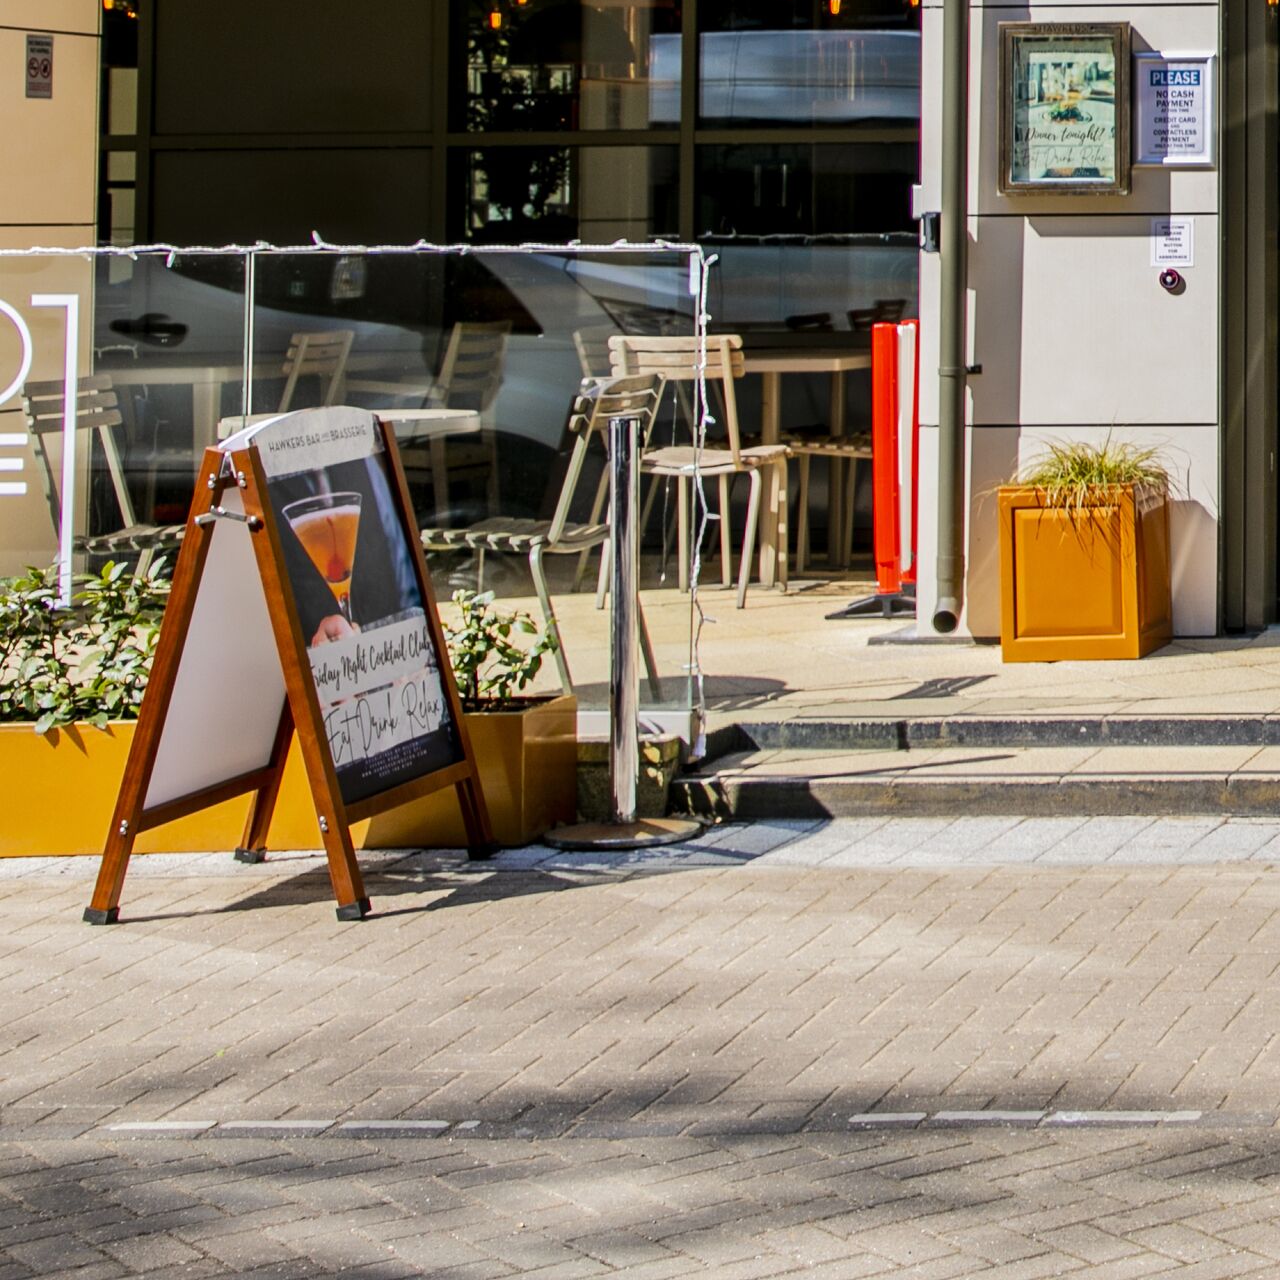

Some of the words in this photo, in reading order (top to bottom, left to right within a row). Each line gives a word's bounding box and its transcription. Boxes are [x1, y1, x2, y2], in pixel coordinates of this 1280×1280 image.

[1152, 72, 1199, 85] PLEASE
[1156, 90, 1168, 98] NO
[1171, 90, 1194, 98] CASH
[1156, 100, 1194, 108] PAYMENT
[268, 436, 306, 453] HAWKERS
[306, 433, 320, 447] BAR
[329, 425, 367, 440] BRASSERIE
[311, 662, 342, 692] riday
[340, 643, 368, 685] Night
[369, 634, 407, 671] Cocktail
[408, 625, 431, 658] Club
[324, 707, 359, 763] Eat
[355, 691, 399, 760] Drink
[401, 680, 440, 739] Relax
